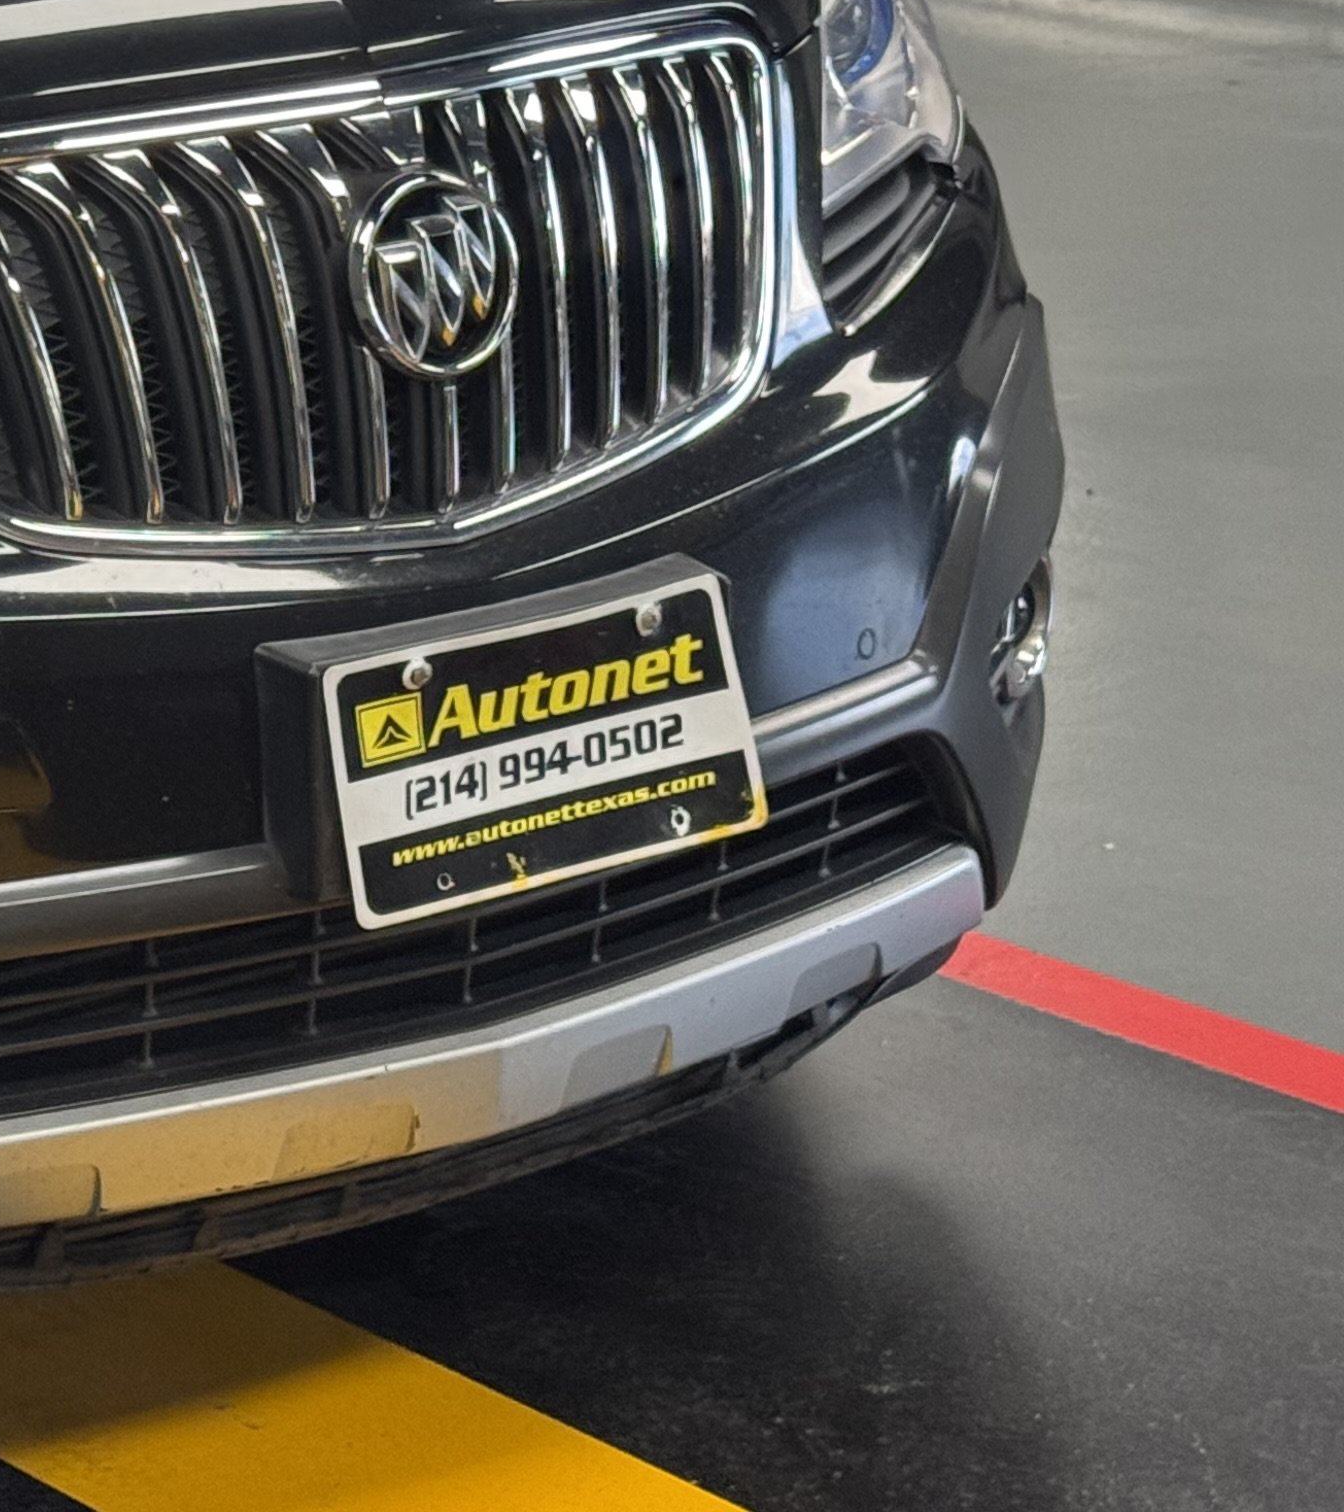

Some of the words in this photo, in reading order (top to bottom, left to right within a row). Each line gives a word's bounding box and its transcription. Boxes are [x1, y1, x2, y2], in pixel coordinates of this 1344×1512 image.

[428, 634, 704, 747] Autonet
[392, 771, 717, 866] www.autonettexas.com
[406, 761, 487, 820] (214)
[499, 713, 684, 790] 994-0502
